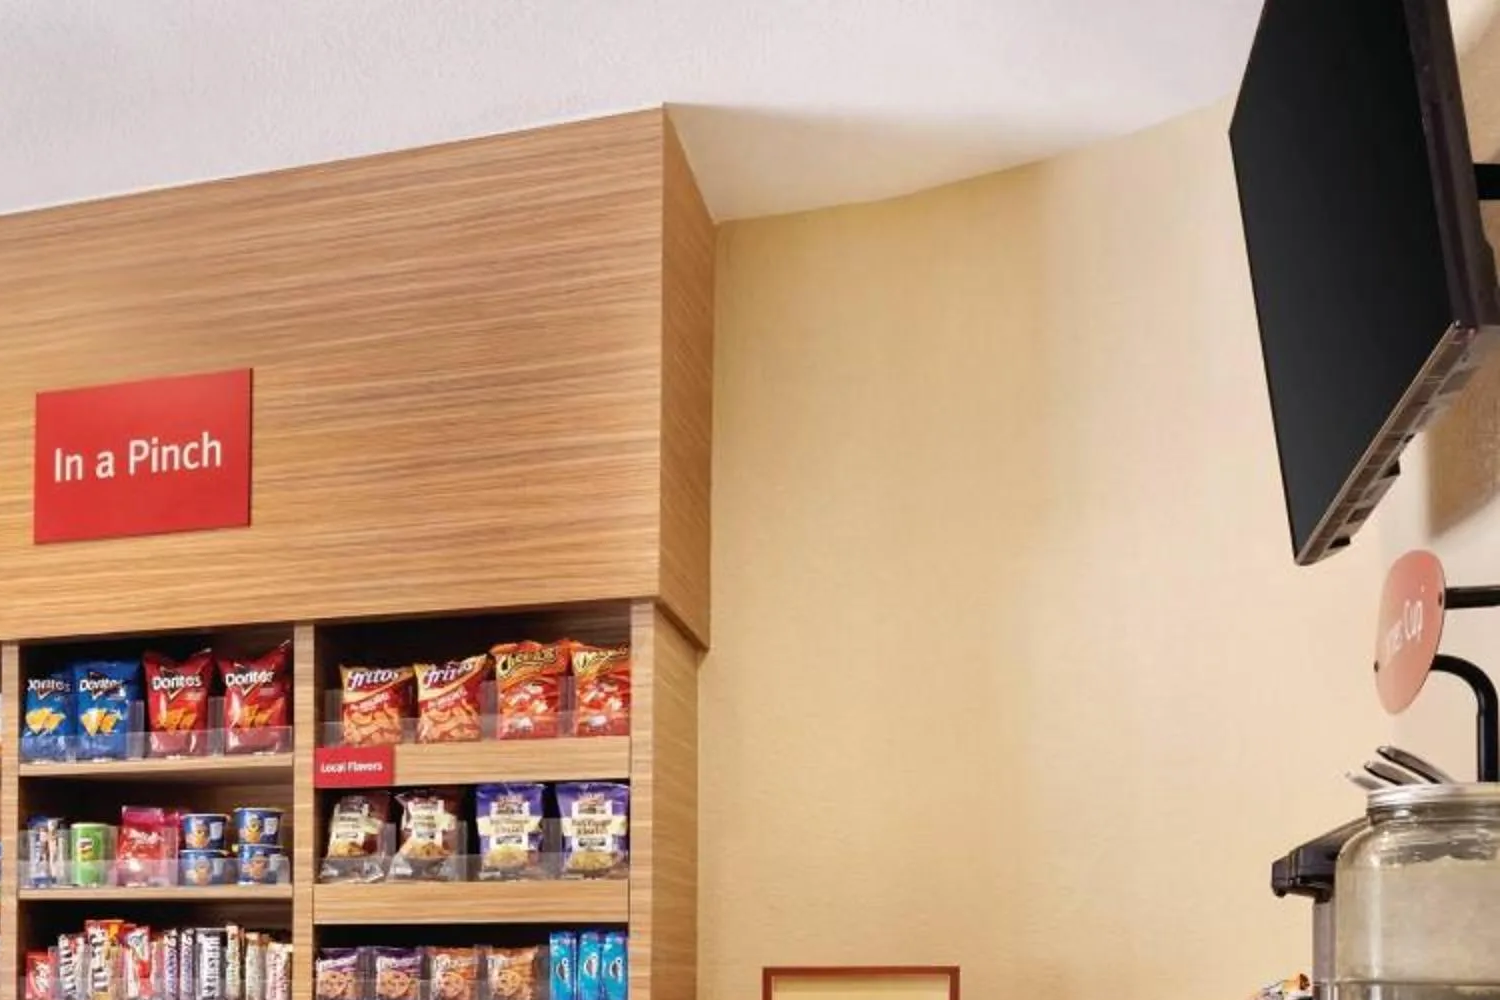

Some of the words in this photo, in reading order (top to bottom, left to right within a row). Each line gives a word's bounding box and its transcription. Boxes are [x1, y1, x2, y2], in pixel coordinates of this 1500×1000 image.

[54, 447, 83, 483] In
[95, 450, 115, 479] a
[128, 430, 222, 476] Pinch
[152, 674, 202, 691] Doritos
[225, 670, 275, 688] Doritos
[321, 762, 346, 773] Local
[347, 761, 383, 773] Flavors
